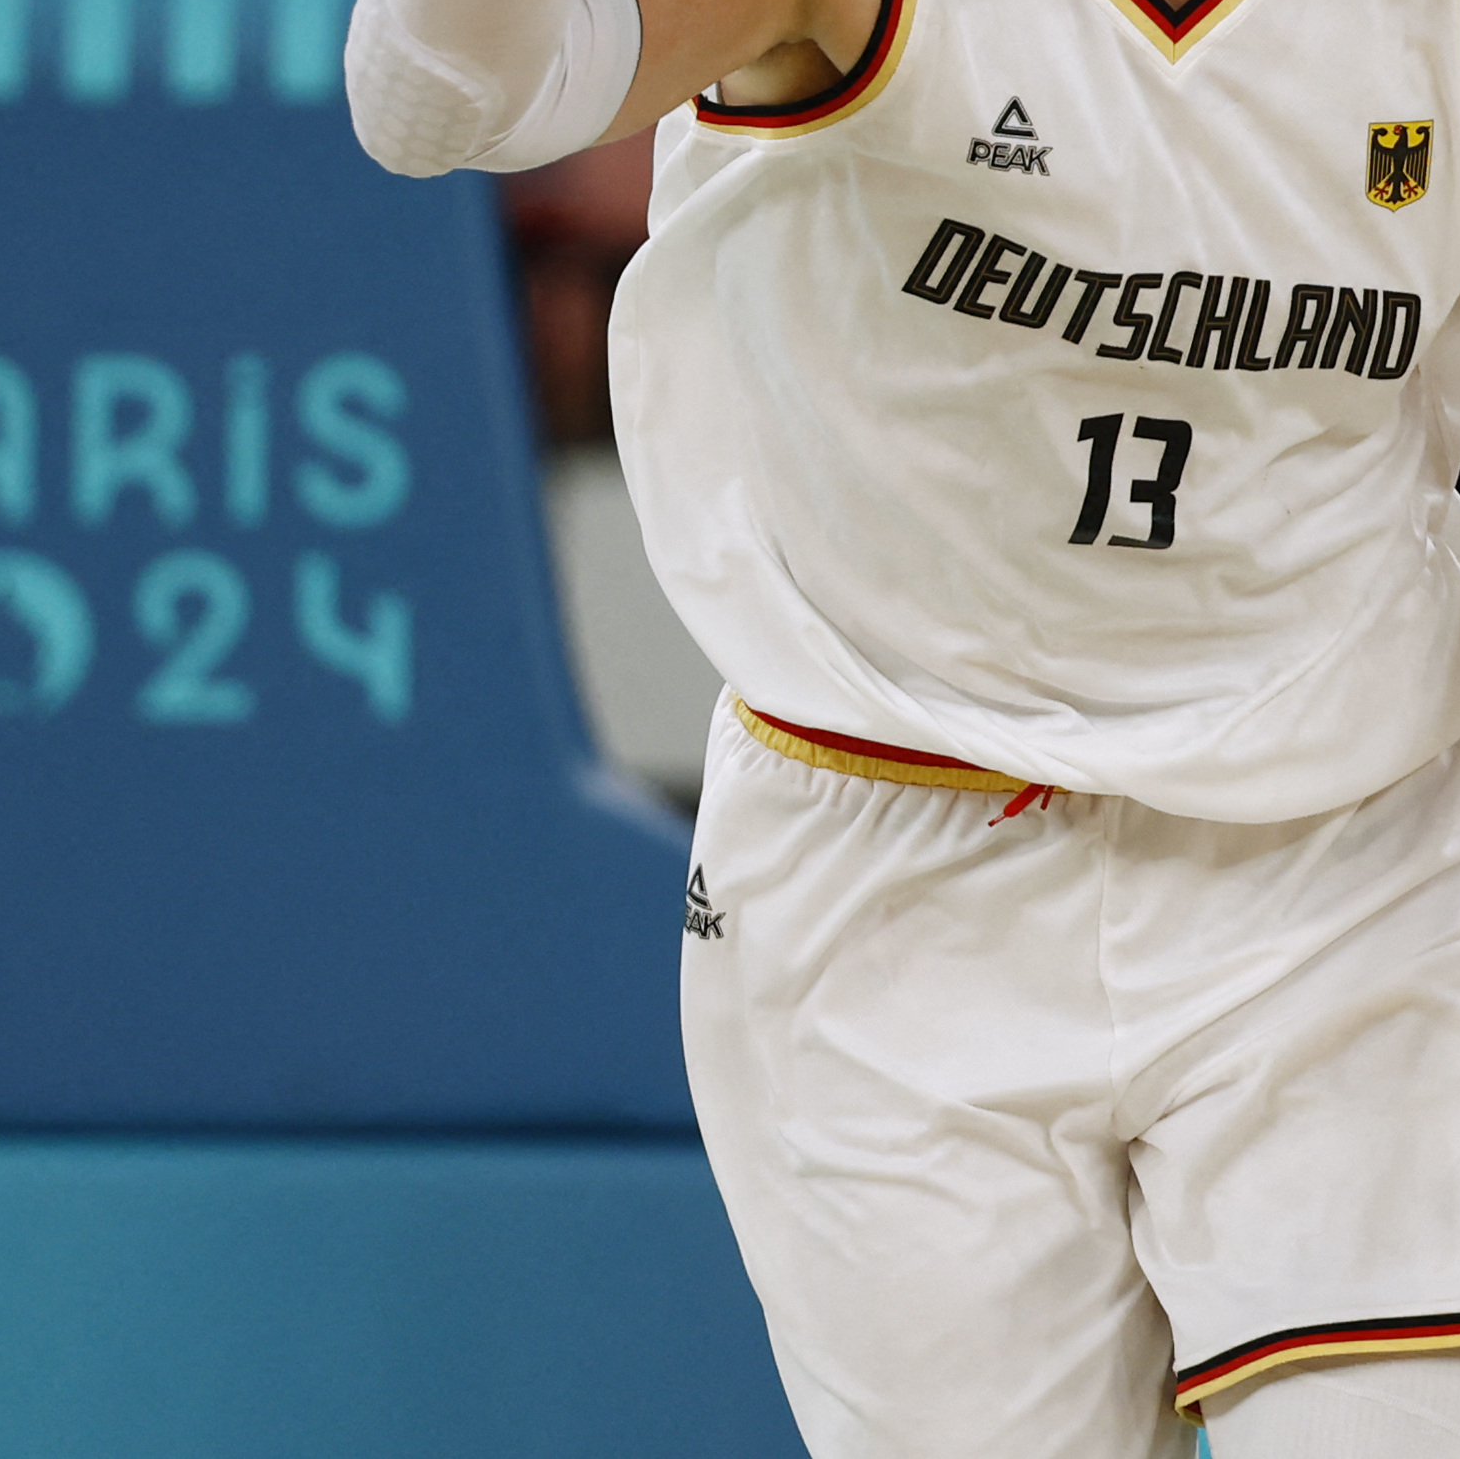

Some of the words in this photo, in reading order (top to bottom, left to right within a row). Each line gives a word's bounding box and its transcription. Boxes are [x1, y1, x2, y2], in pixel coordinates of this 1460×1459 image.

[966, 137, 1053, 177] PEAK
[902, 218, 1421, 380] DEUTSCHLAND
[1068, 413, 1192, 550] 13
